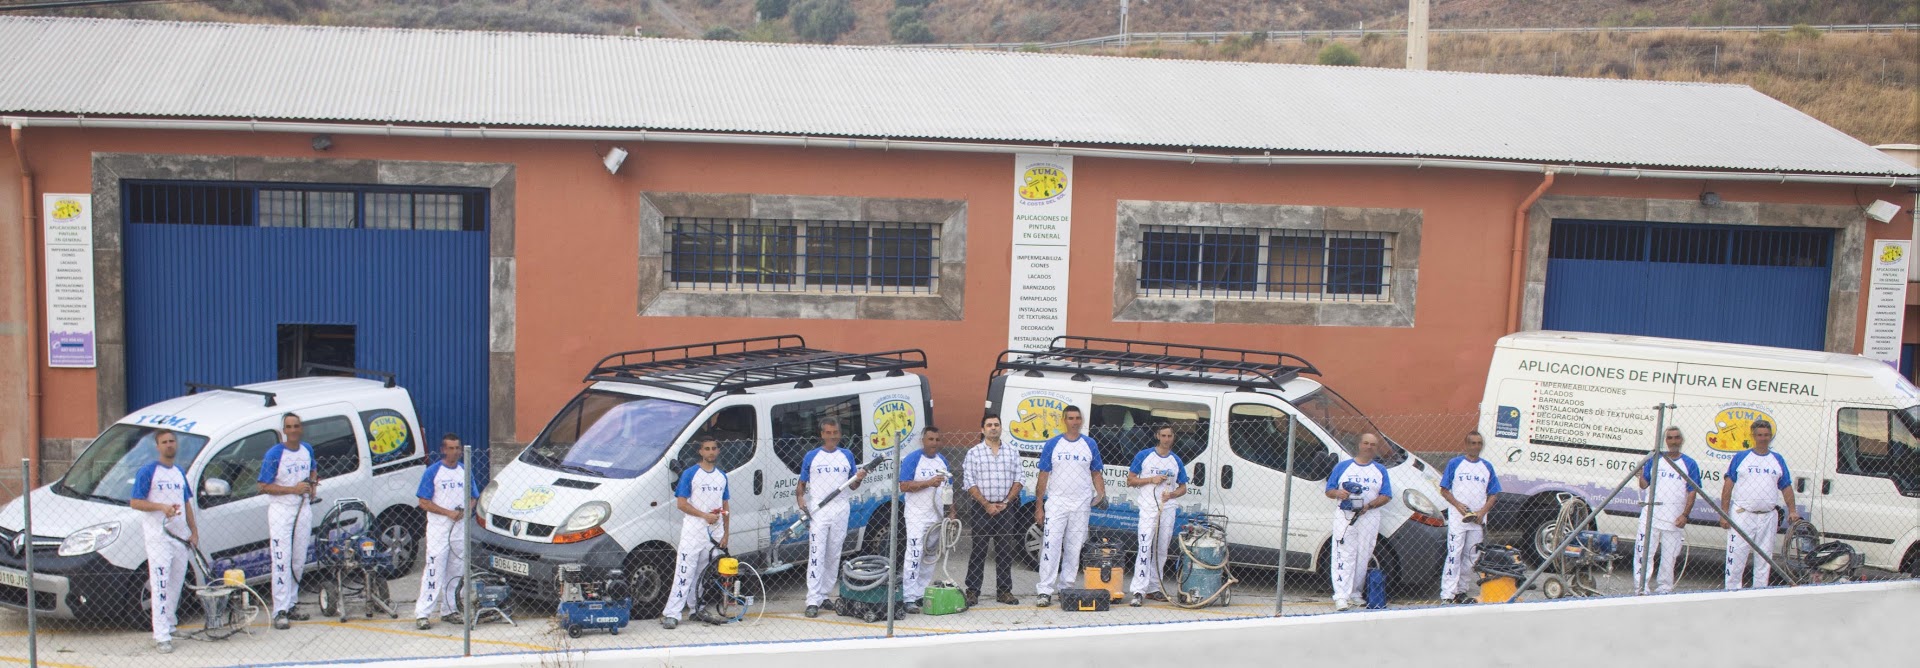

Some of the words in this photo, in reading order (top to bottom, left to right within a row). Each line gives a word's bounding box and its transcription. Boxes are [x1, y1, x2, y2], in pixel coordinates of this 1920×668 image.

[1518, 360, 1625, 380] APLICACIONES
[1629, 370, 1648, 382] DE
[1652, 372, 1717, 387] PINTURA
[1722, 377, 1742, 389] EN
[1746, 379, 1819, 397] GENERAL
[1540, 382, 1626, 395] IMPERMEABILIZACIONES
[880, 403, 905, 415] YUMA
[1028, 399, 1063, 411] YUMA
[1539, 397, 1584, 406] BARNIZADOS
[1537, 412, 1584, 422] DECORACIÓN
[1538, 405, 1593, 415] INSTALACIONES
[1607, 411, 1655, 421] TEXTURGLAS
[1727, 411, 1763, 420] YUMA
[136, 415, 196, 432] YUMA
[375, 417, 397, 426] YUMA
[1536, 419, 1590, 429] RESTAURACIÓN
[1604, 425, 1643, 435] FACHADAS
[1535, 434, 1587, 444] EMPAPELADOS
[1536, 426, 1584, 436] ENVEJECIDOS
[1592, 432, 1622, 440] PATINAS
[880, 462, 888, 472] EN
[1530, 452, 1550, 462] 952
[1553, 454, 1573, 465] 494
[1576, 456, 1596, 468] 651
[1606, 460, 1627, 471] 607
[774, 477, 798, 489] APLIC
[274, 539, 284, 585] YUMA
[810, 534, 818, 579] YUMA
[910, 538, 920, 580] YUMA
[1447, 534, 1455, 575] YUMA
[1726, 534, 1736, 576] YUMA
[427, 556, 437, 602] YUMA
[676, 553, 687, 598] YUMA
[158, 566, 167, 615] YUMA
